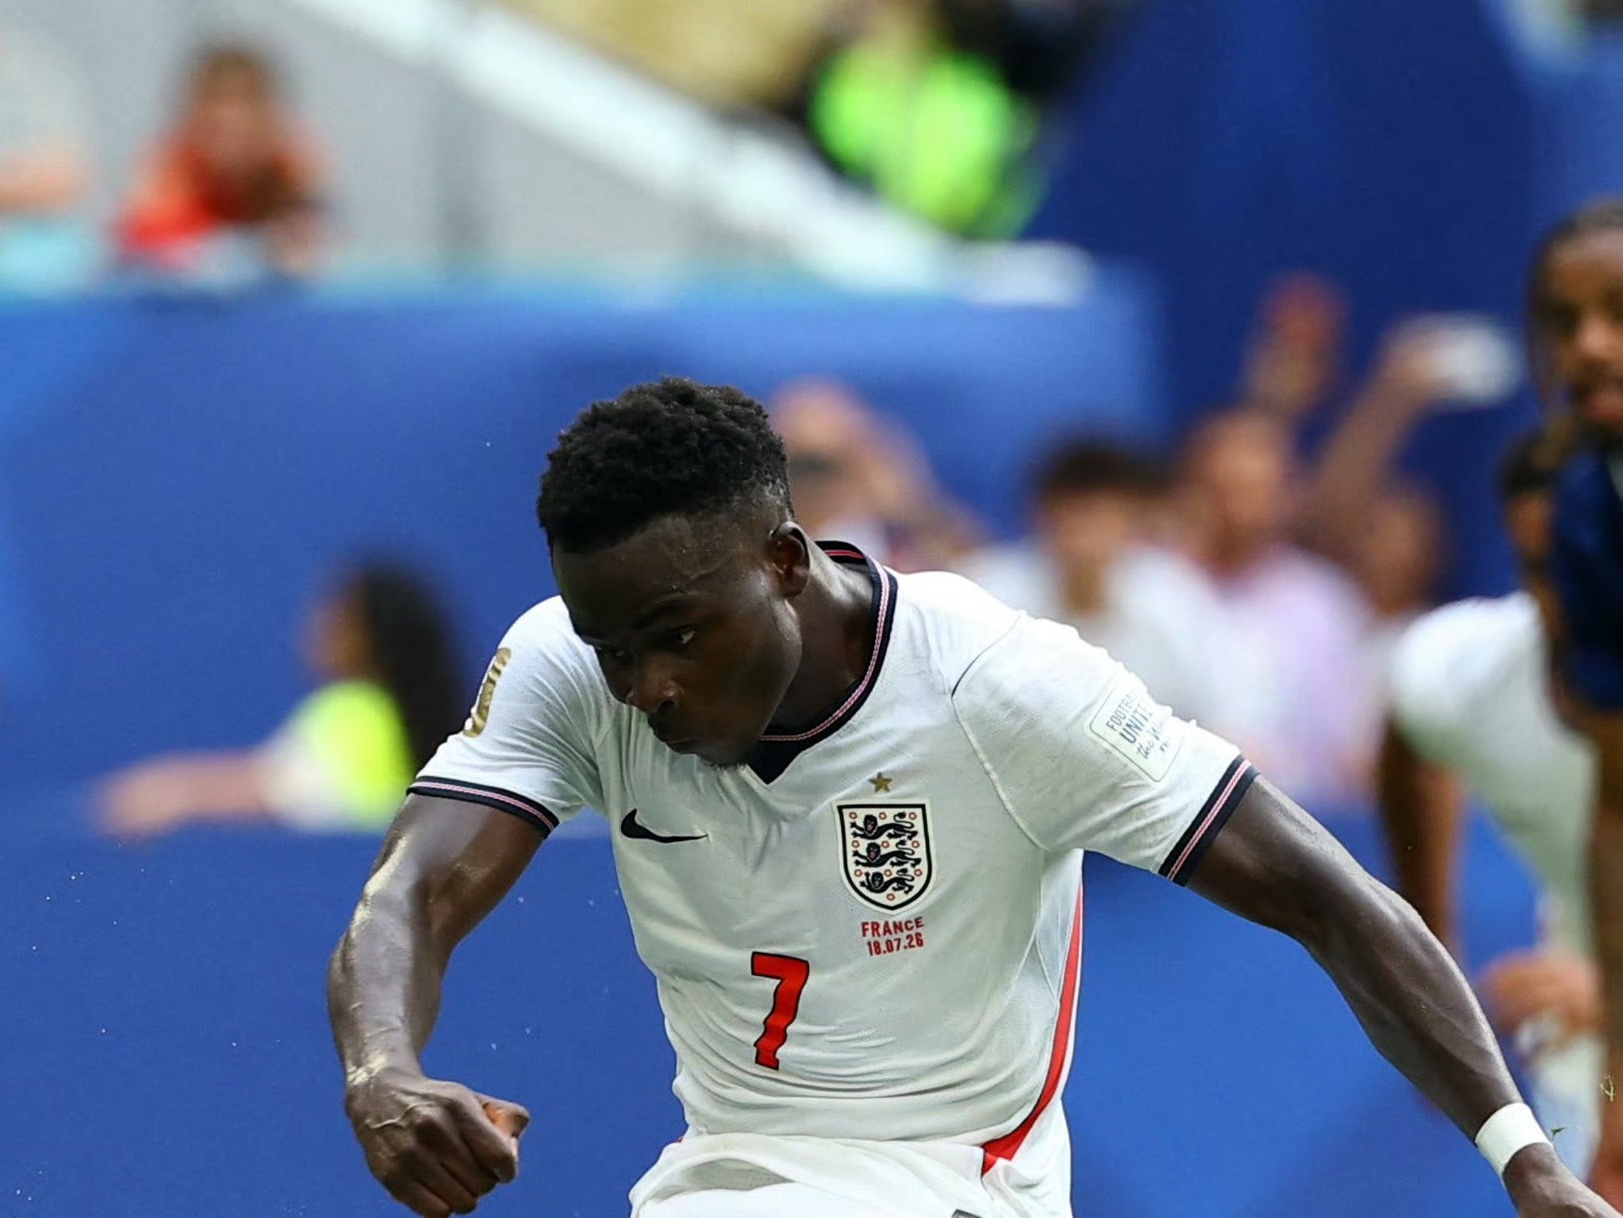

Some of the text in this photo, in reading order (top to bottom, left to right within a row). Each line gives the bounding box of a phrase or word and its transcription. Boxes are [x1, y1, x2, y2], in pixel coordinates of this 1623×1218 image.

[861, 916, 924, 938] FRANCE
[867, 932, 924, 956] 18.07.26
[750, 951, 810, 1071] 7
